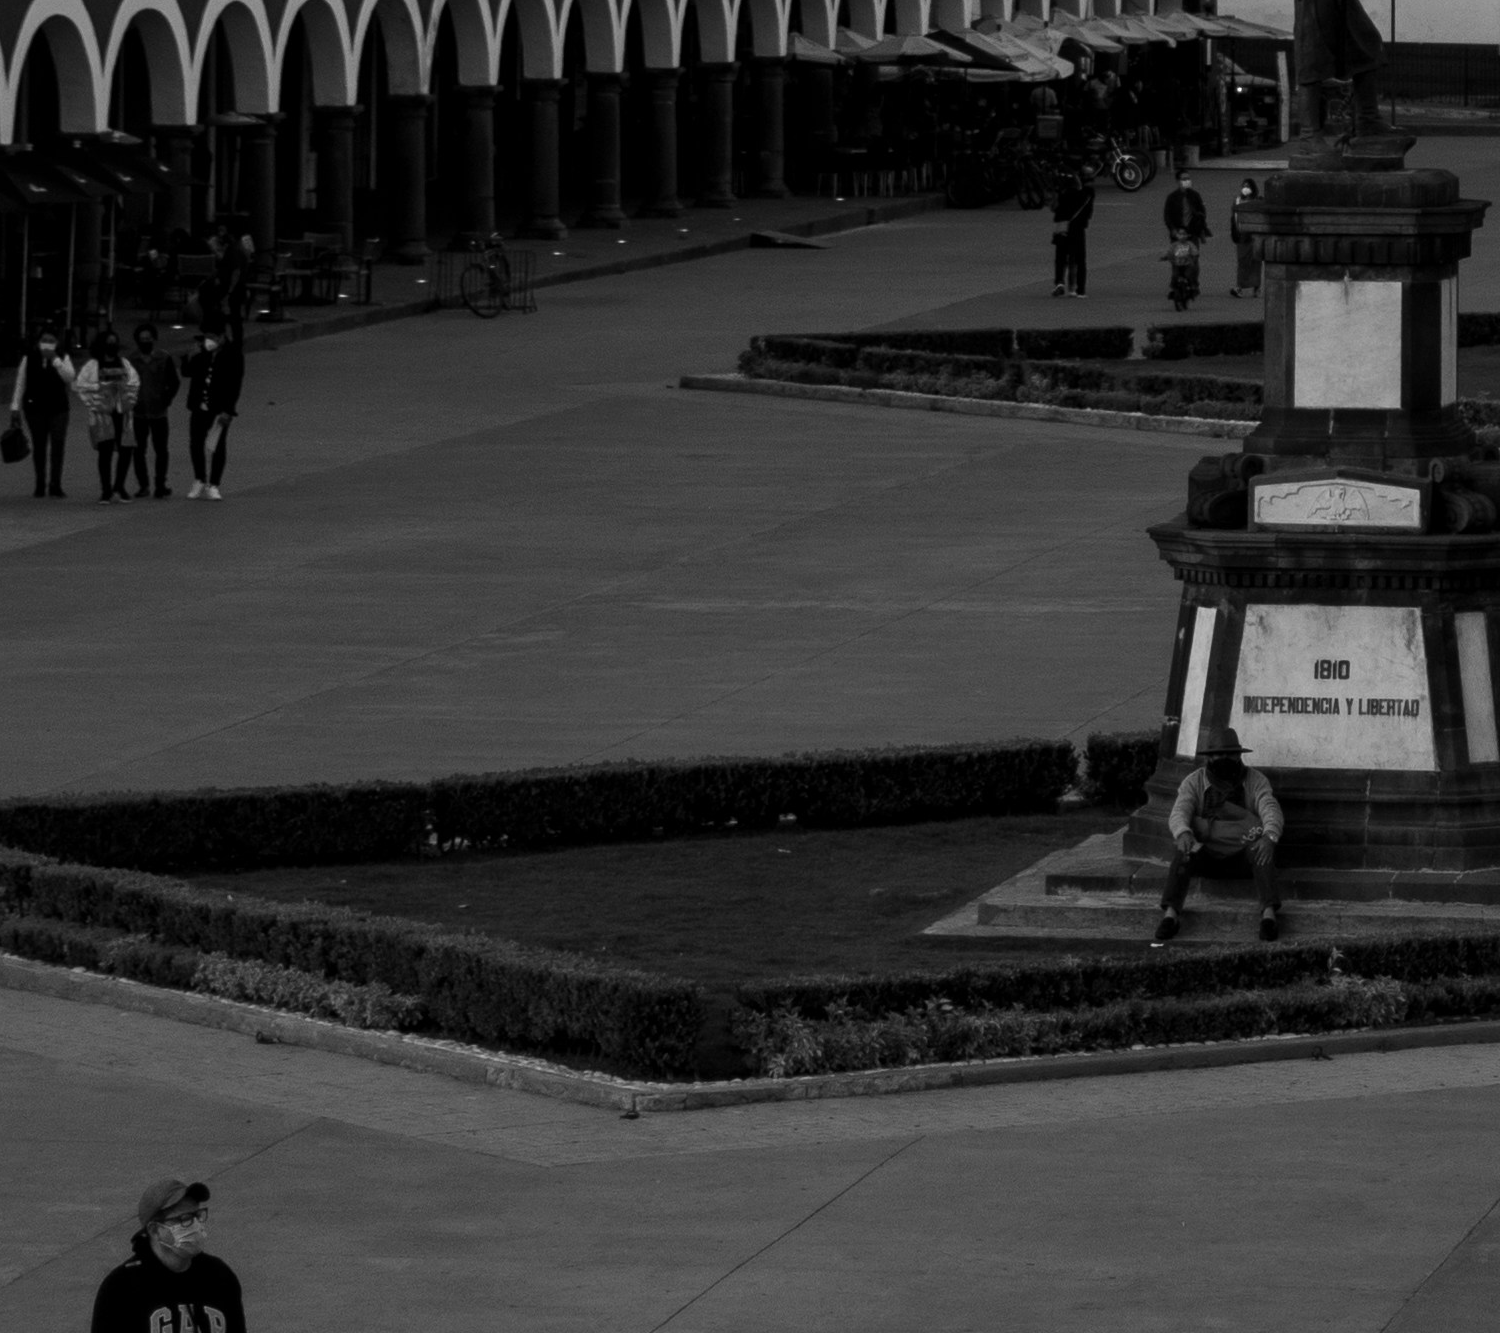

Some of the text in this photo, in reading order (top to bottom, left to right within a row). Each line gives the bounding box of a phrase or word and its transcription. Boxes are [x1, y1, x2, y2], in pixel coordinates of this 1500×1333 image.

[1314, 659, 1351, 681] 1810
[1243, 695, 1420, 718] INDEPENDENCIA Y LIBERTAD
[149, 1303, 227, 1333] GAP
